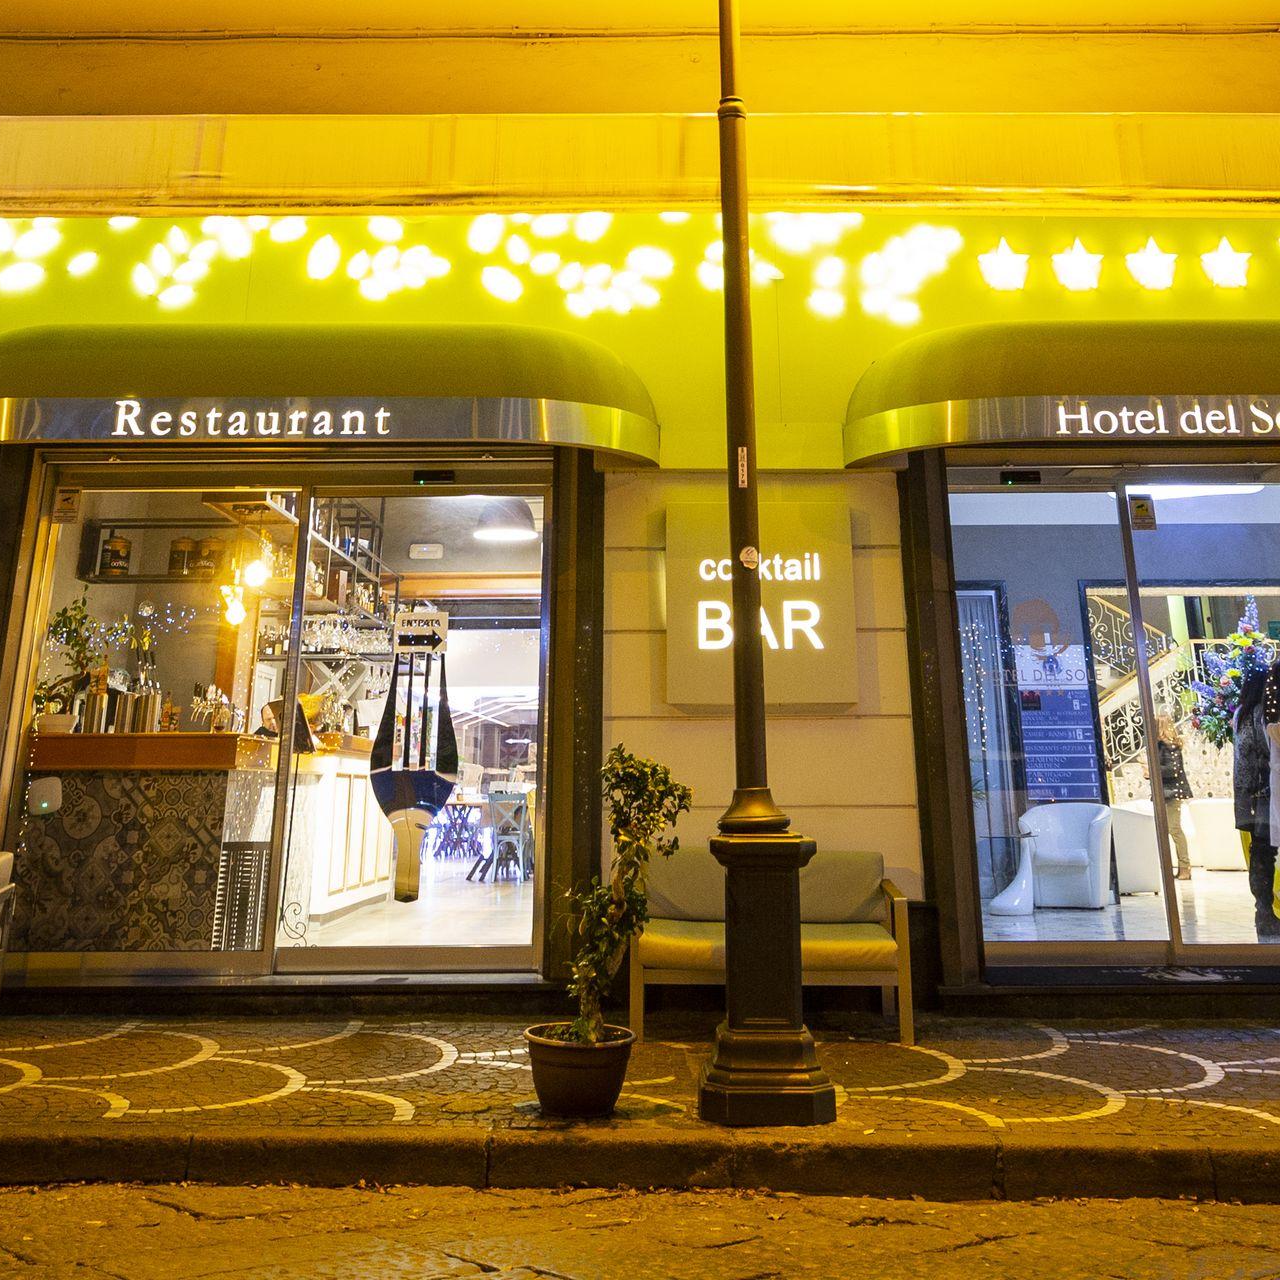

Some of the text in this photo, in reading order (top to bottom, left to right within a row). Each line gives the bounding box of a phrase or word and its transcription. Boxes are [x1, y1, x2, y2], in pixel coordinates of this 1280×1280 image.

[110, 400, 392, 436] Restaurant
[1055, 400, 1169, 435] Hotel
[1179, 400, 1240, 435] del
[698, 552, 821, 581] coktail
[1065, 669, 1103, 682] SOLE
